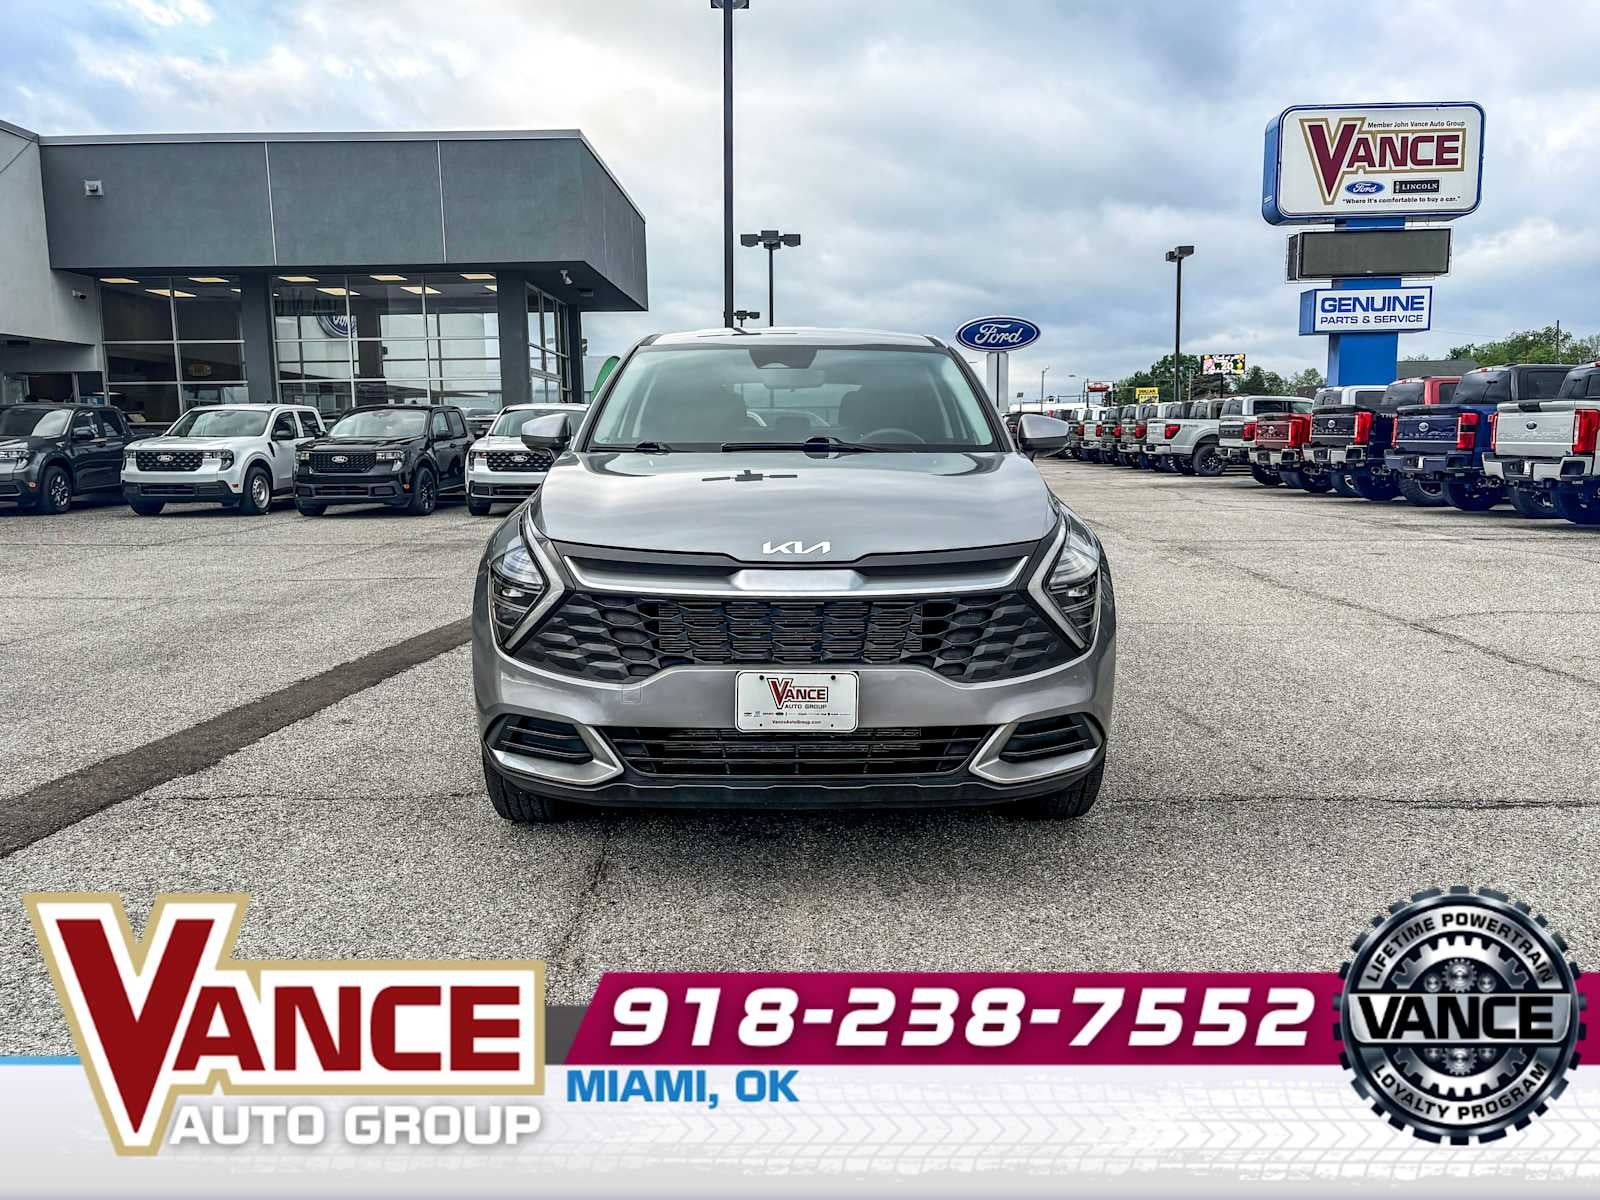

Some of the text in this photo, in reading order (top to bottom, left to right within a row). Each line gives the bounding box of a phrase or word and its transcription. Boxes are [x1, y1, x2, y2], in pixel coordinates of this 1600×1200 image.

[1429, 120, 1445, 128] Auto
[1446, 120, 1465, 128] Group
[1307, 124, 1461, 198] VANCE
[1352, 182, 1377, 193] Ford
[1401, 182, 1438, 191] LINCOLN
[1320, 295, 1425, 313] GENUINE
[1320, 314, 1423, 325] PARTS & SERVICE
[974, 323, 1024, 345] Ford
[762, 541, 831, 554] KIA
[769, 680, 827, 705] VANCE
